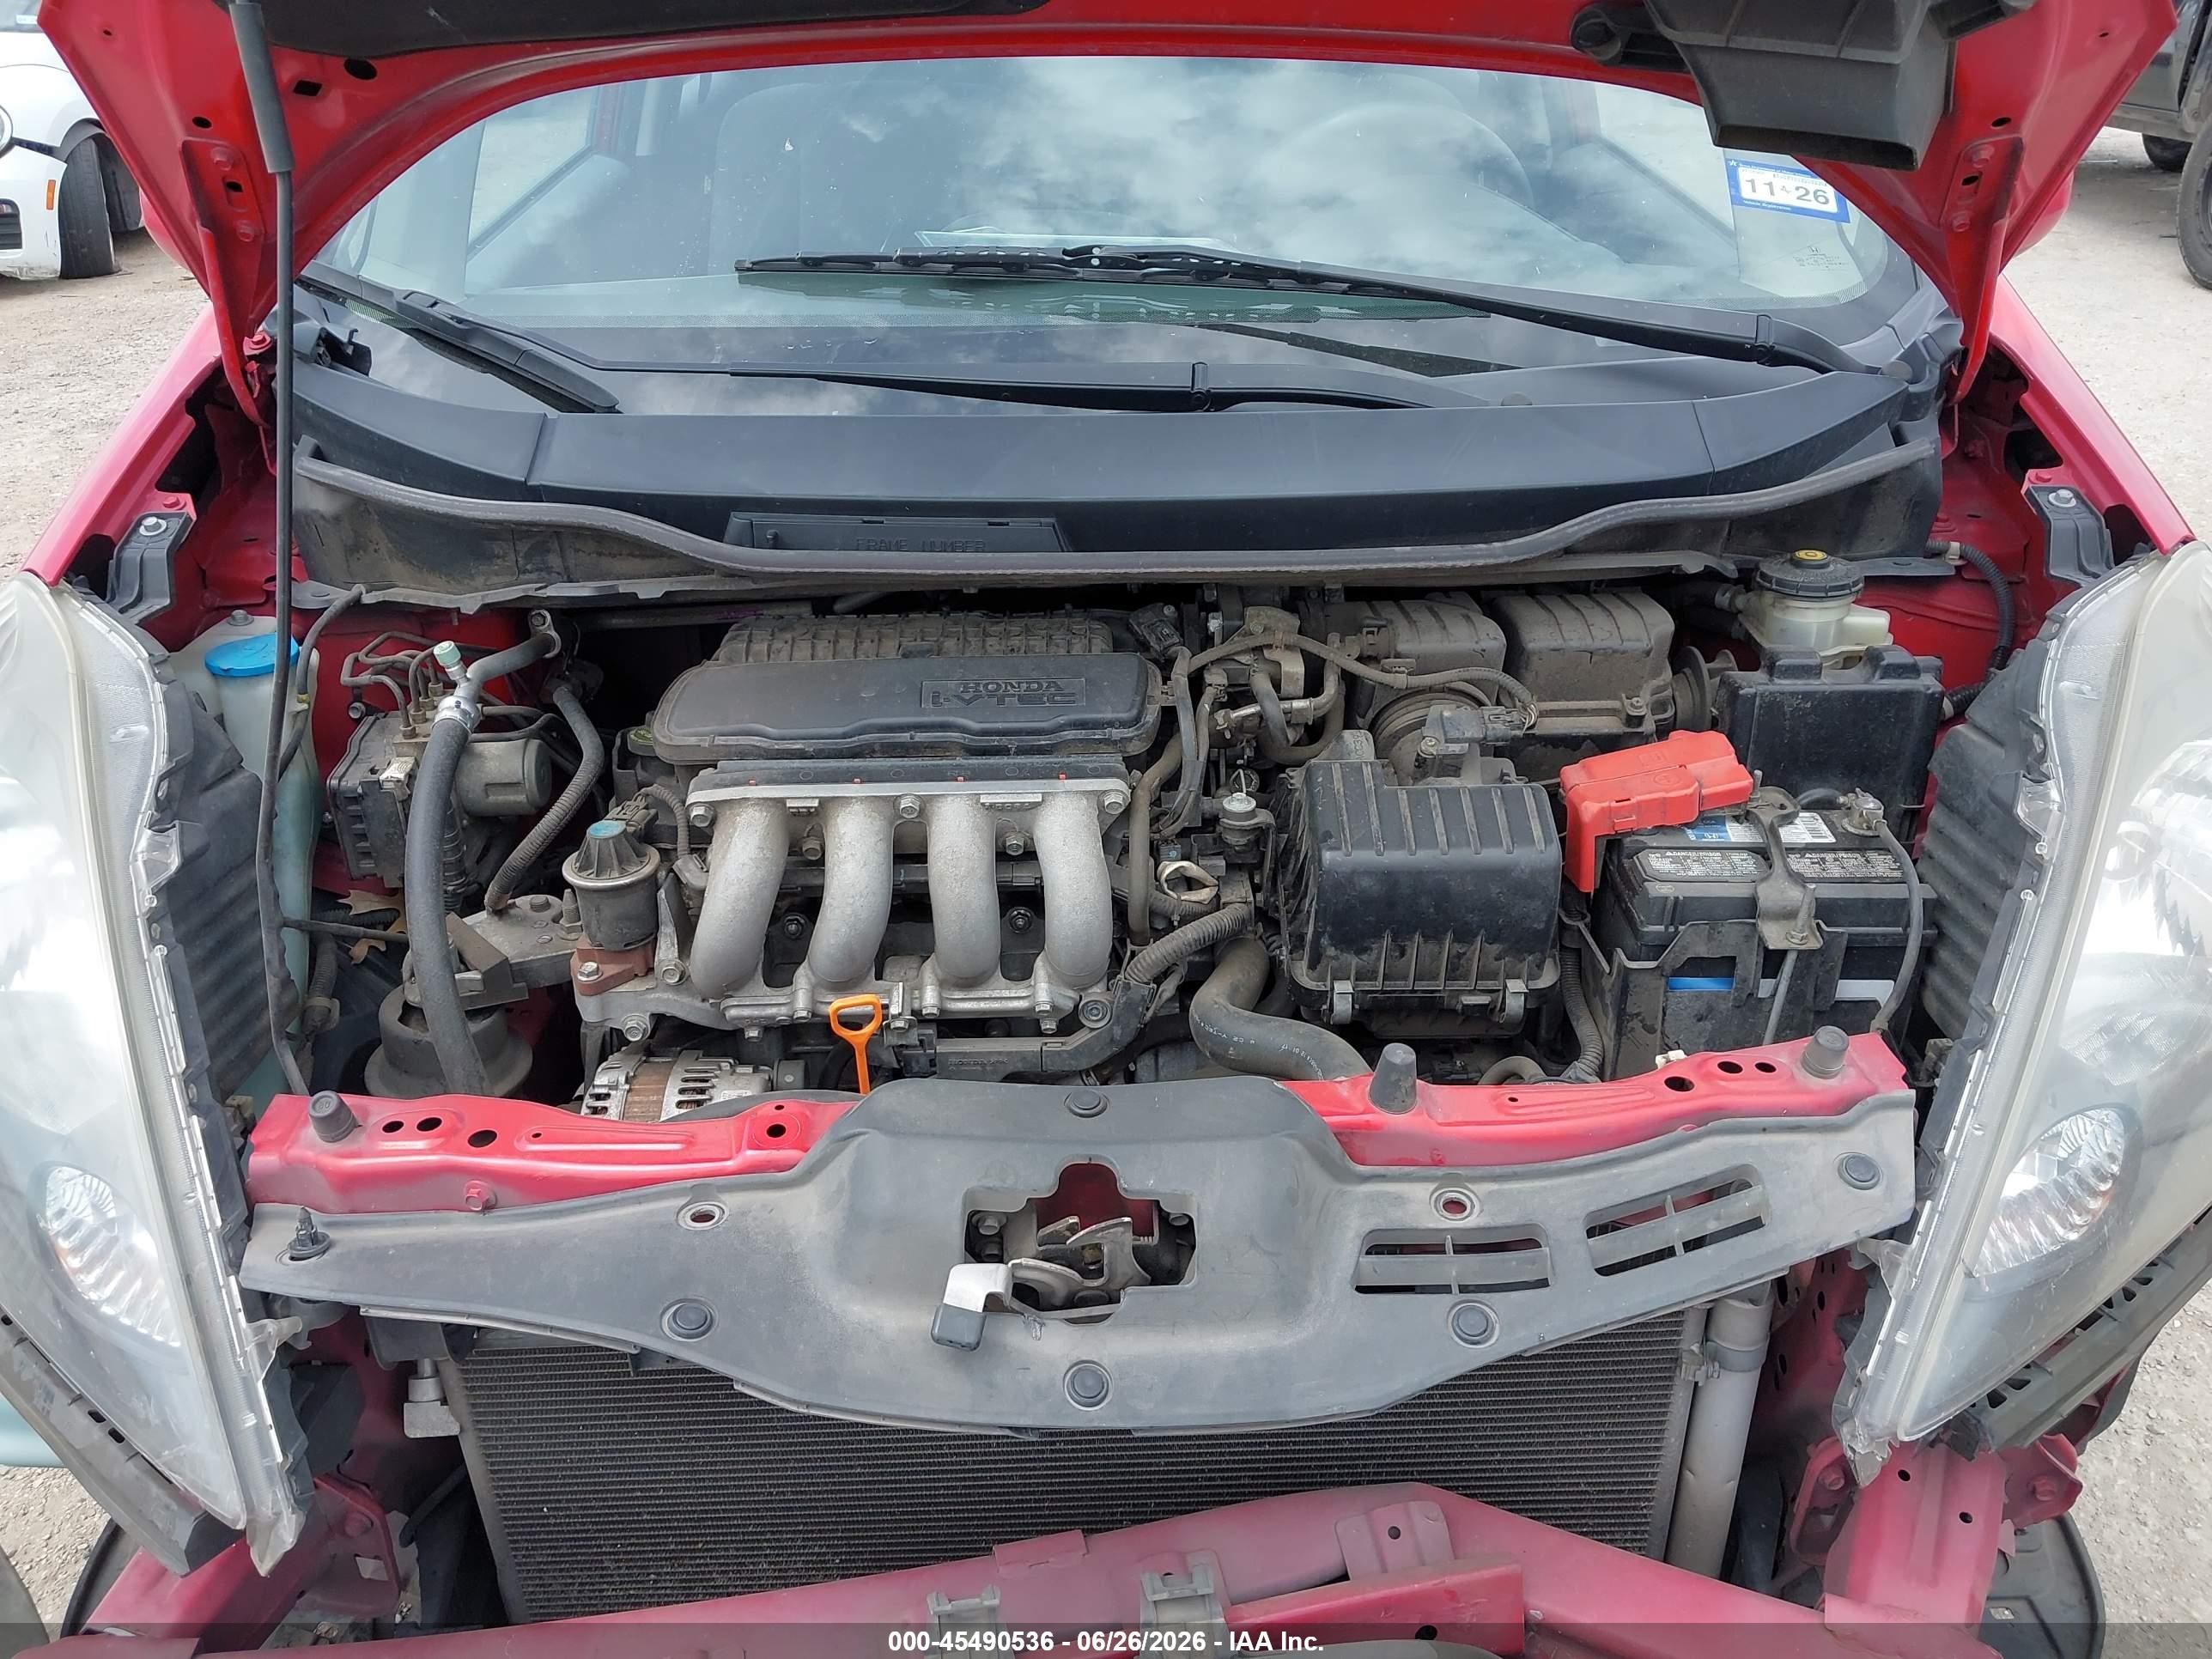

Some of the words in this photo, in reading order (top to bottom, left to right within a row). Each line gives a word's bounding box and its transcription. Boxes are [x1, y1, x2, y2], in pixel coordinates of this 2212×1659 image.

[856, 538, 908, 551] FRAME
[921, 538, 987, 552] NUMBER
[960, 680, 1065, 694] HONDA
